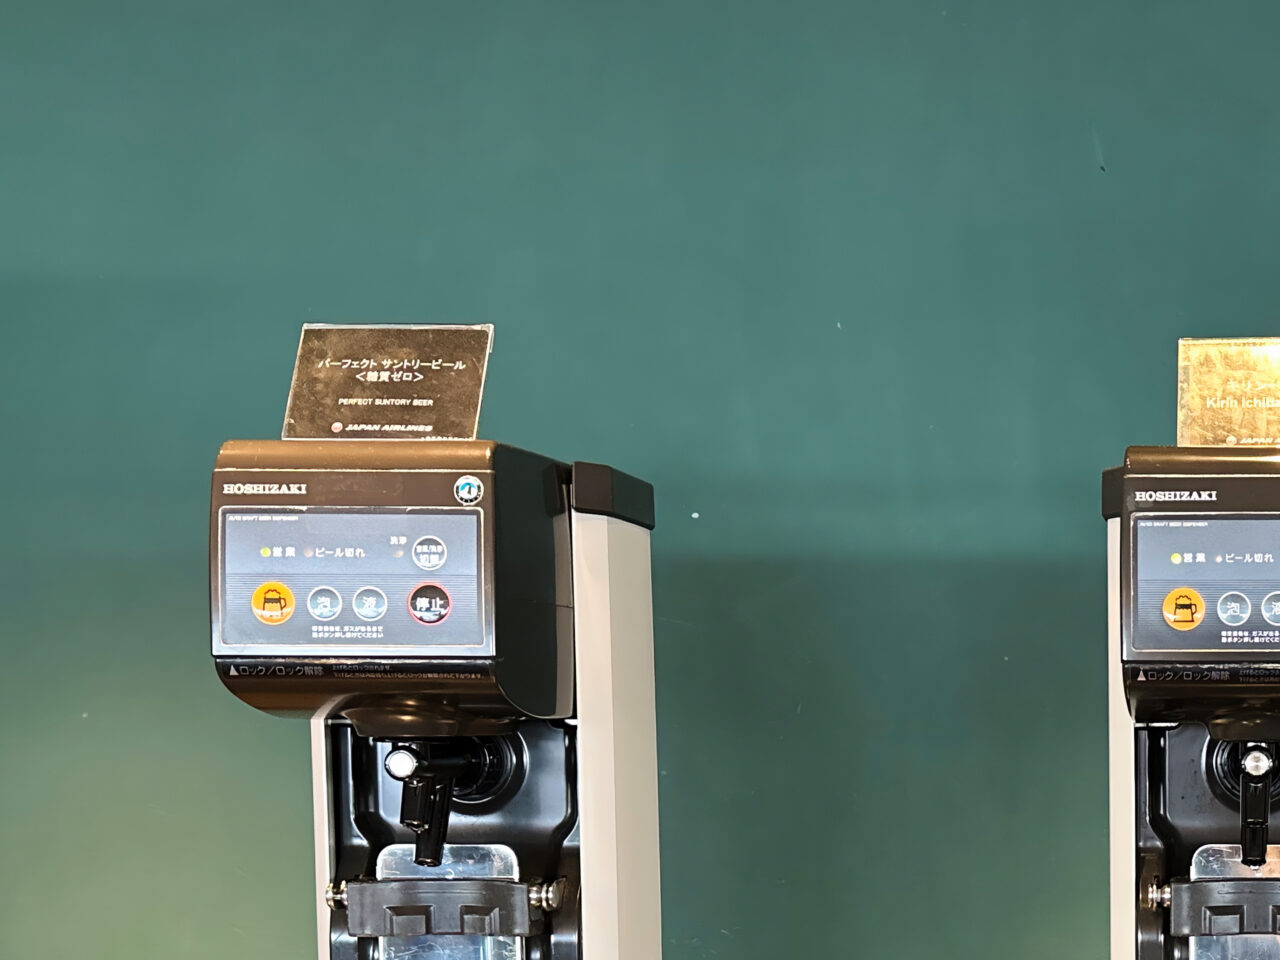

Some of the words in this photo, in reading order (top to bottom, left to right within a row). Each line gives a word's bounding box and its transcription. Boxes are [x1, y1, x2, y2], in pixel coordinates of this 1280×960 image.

[382, 358, 466, 370] サントリービール
[338, 398, 373, 406] PERFECT
[374, 398, 411, 406] SUNTORY
[413, 399, 434, 407] BEER
[1206, 396, 1238, 409] Kirin
[345, 424, 380, 432] JAPAN
[381, 424, 434, 432] AIRLINES
[222, 483, 307, 495] HOSHIZAKI
[1134, 490, 1218, 502] HOSHIZAKI
[315, 547, 366, 558] ビール切れ
[1225, 552, 1274, 564] ビール切れ
[416, 596, 444, 611] 停止
